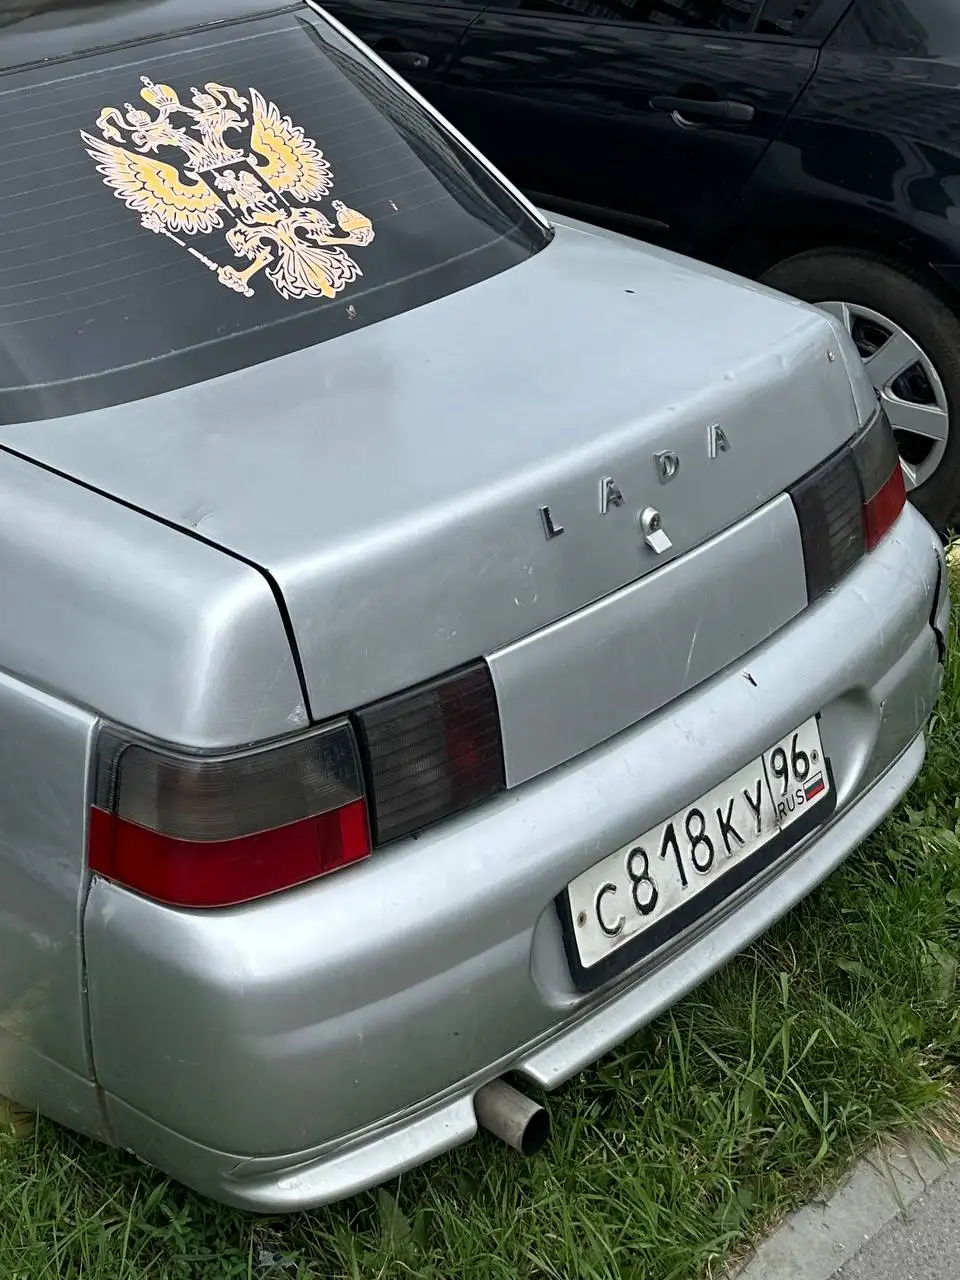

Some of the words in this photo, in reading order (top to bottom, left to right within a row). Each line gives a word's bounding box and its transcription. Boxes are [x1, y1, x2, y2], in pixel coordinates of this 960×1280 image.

[538, 423, 733, 540] LADA
[770, 732, 810, 796] 96
[777, 788, 805, 821] RUS
